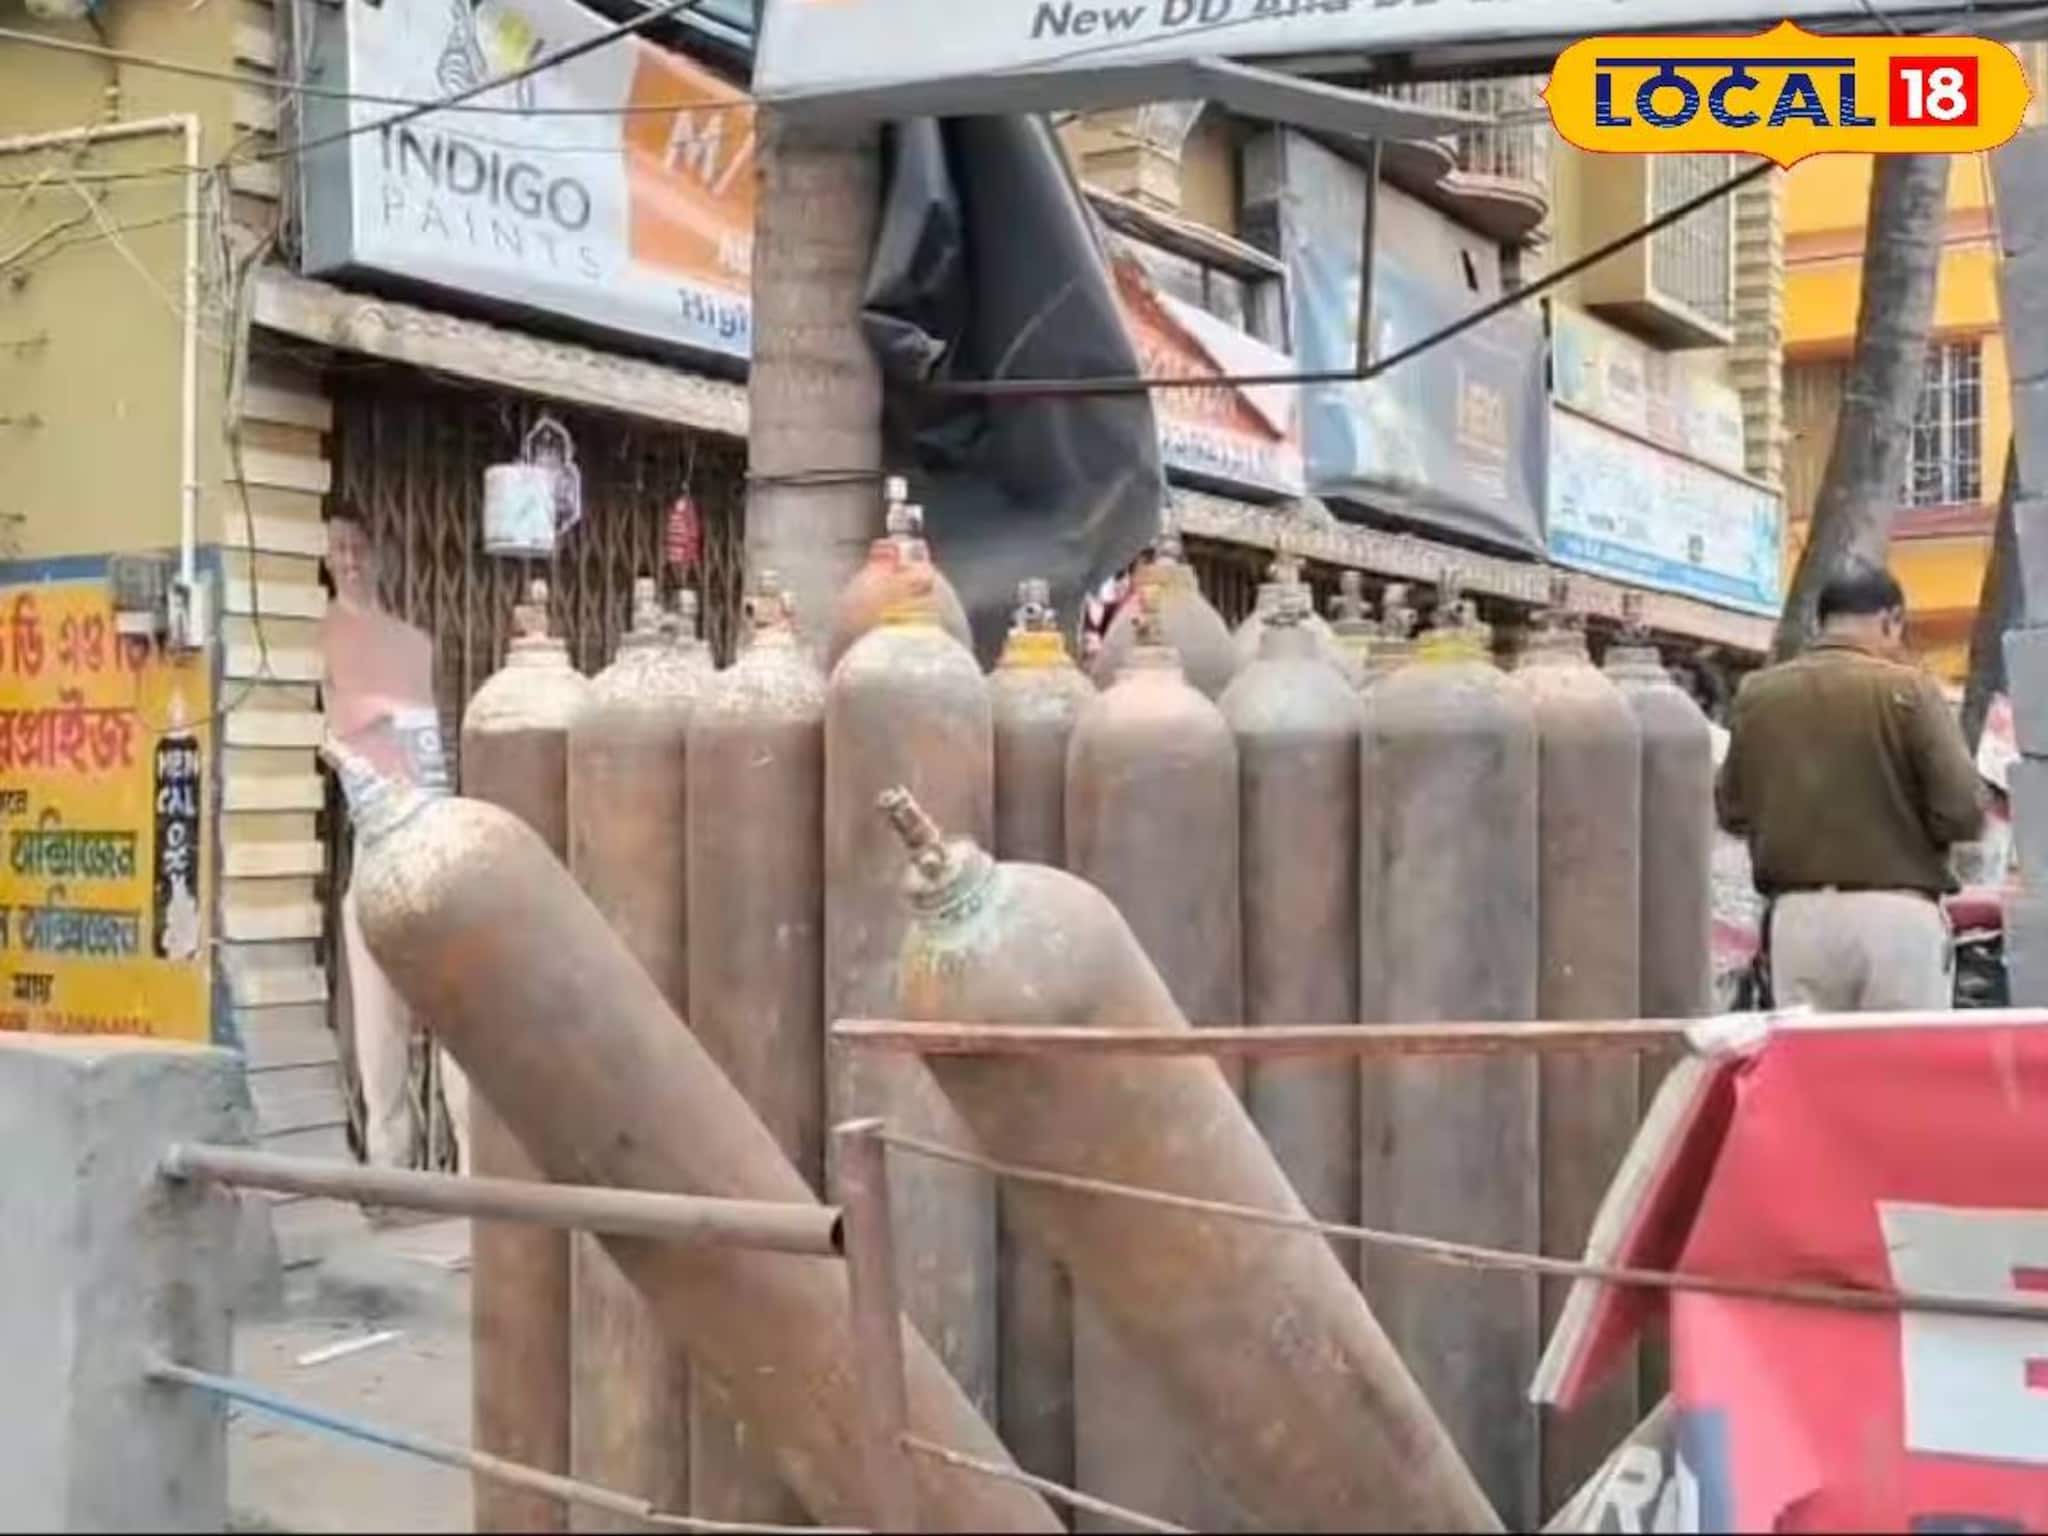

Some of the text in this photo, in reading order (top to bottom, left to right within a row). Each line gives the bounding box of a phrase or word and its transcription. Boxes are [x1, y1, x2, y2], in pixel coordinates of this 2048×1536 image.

[1031, 0, 1147, 38] New
[381, 121, 591, 231] INDIGO
[382, 186, 601, 279] PAINTS
